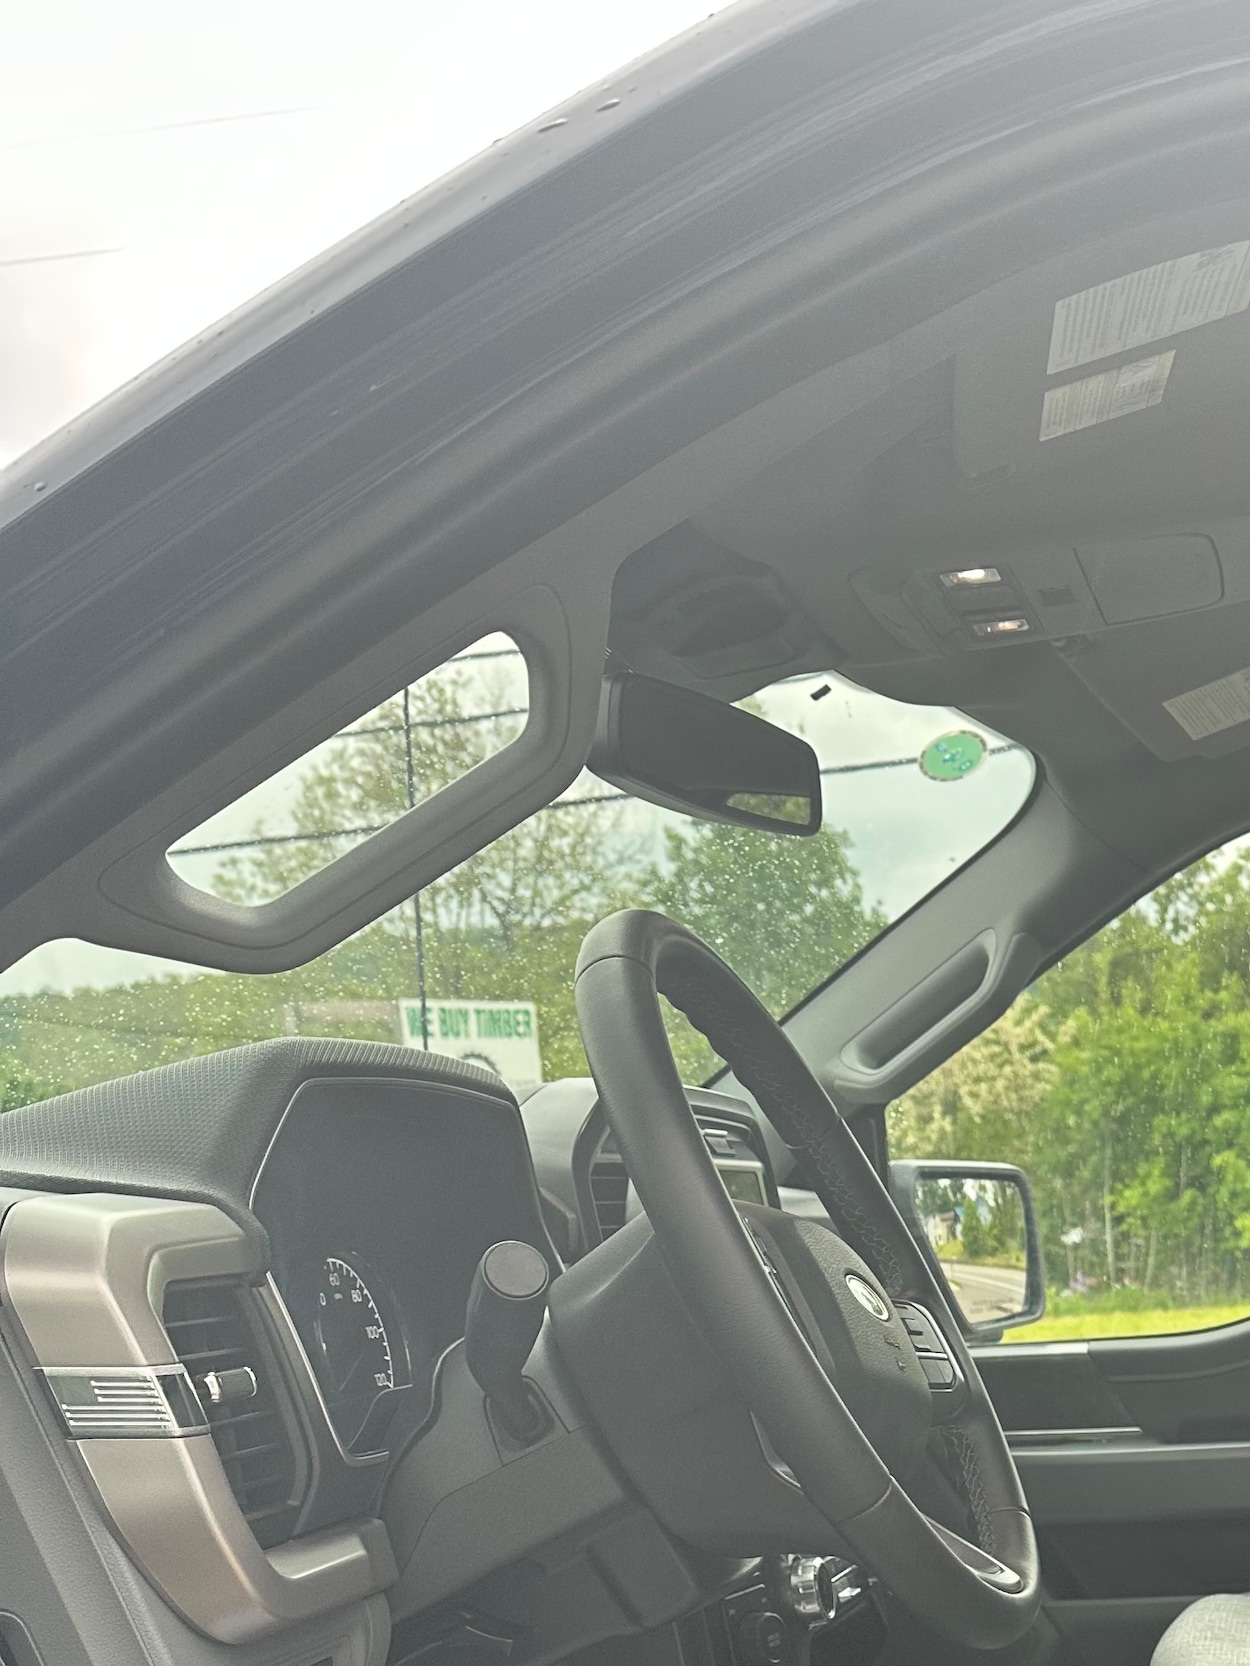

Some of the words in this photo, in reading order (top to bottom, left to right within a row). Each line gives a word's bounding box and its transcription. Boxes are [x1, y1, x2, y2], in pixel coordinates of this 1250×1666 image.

[438, 1007, 469, 1038] BUY
[329, 1273, 340, 1286] 60
[351, 1290, 362, 1302] 80
[366, 1326, 380, 1339] 100
[374, 1373, 388, 1386] 120
